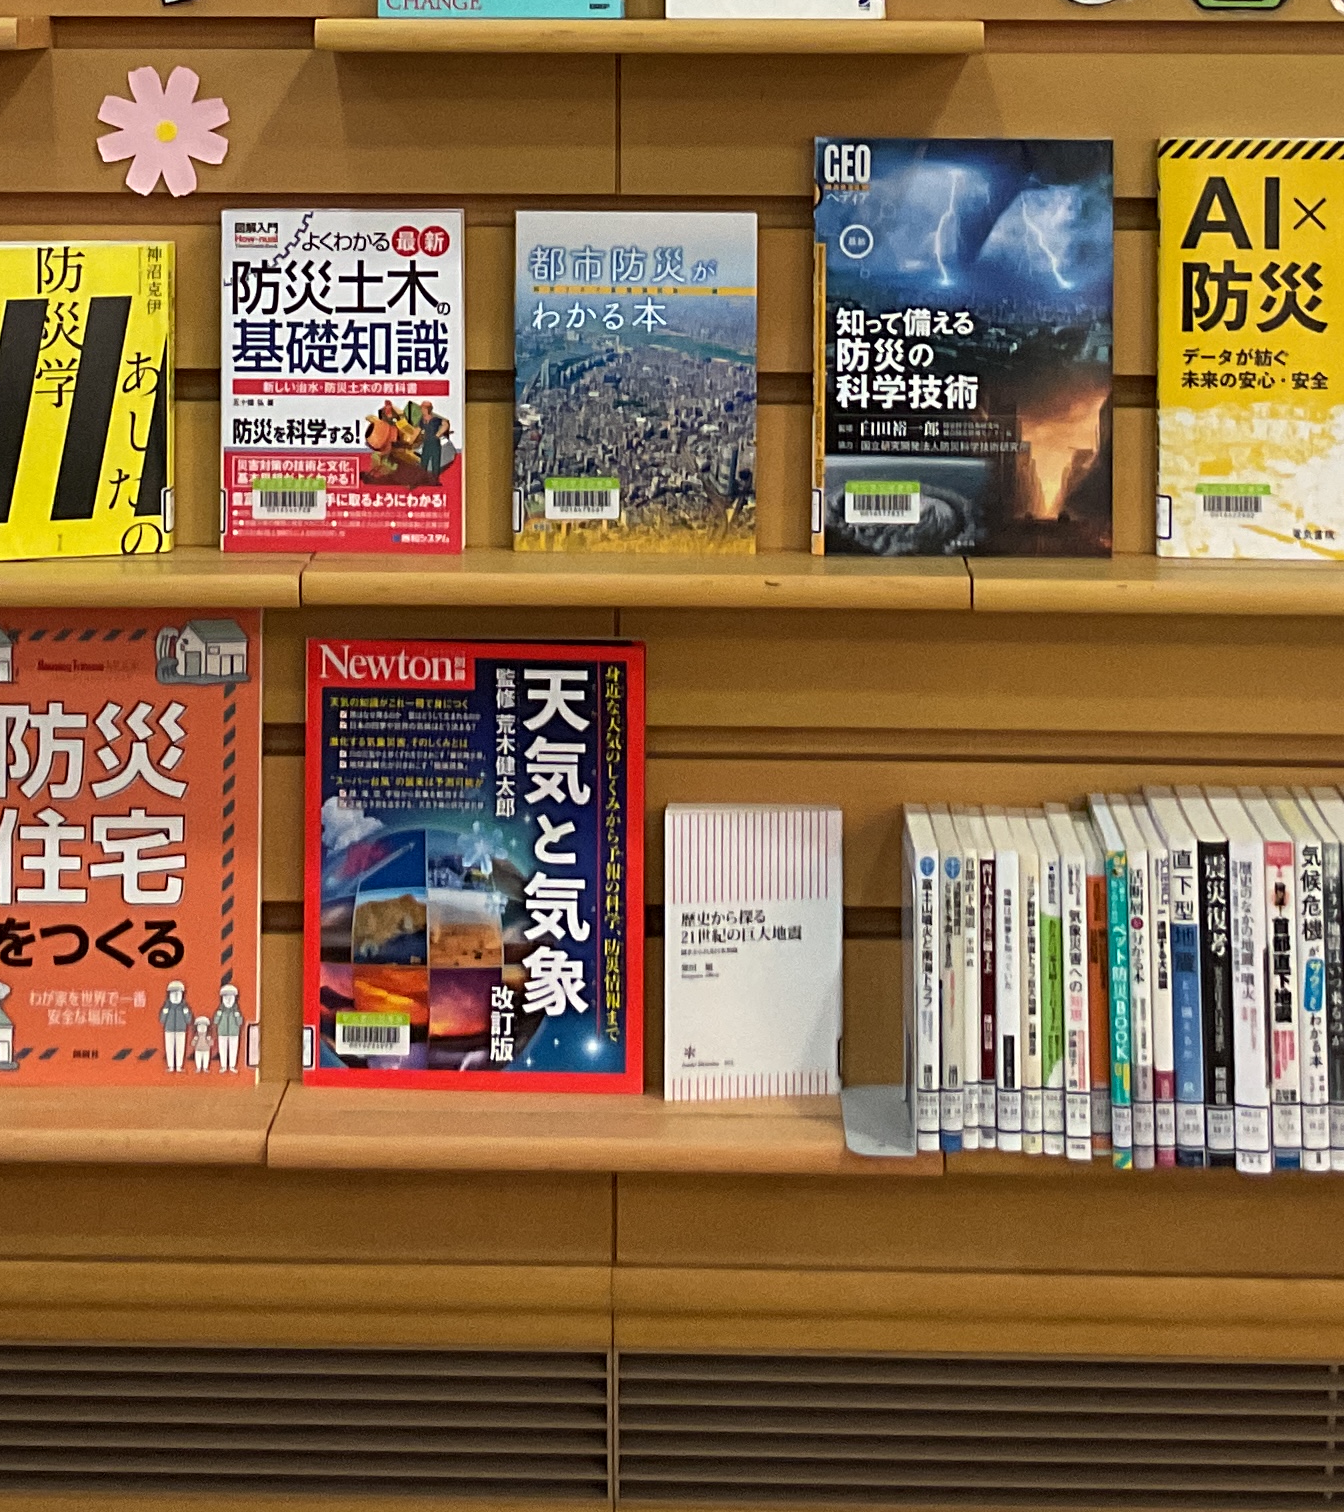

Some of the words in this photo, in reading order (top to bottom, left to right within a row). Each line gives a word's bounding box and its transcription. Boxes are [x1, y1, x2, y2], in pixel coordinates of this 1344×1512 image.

[824, 144, 871, 183] GEO
[234, 222, 279, 234] 図解入門
[302, 231, 389, 251] よくわかる
[396, 230, 445, 253] 最新
[146, 247, 162, 315] 神沼克伊
[530, 246, 717, 284] 都市防災が
[231, 261, 451, 316] 防災土木の
[1181, 261, 1329, 334] 防災
[36, 246, 85, 409] 防災学
[532, 298, 667, 333] わかる本
[836, 309, 974, 338] 知って備える
[232, 319, 449, 374] 基礎知識
[836, 338, 934, 369] 防災の
[1182, 347, 1286, 368] データが紡ぐ
[263, 382, 418, 394] 新しい治水・防災土木の教科書
[836, 374, 978, 410] 科学技術
[1181, 370, 1328, 390] 未来の安心・安全
[233, 418, 361, 445] 防災を科学する！
[109, 351, 162, 555] あしたの
[319, 644, 453, 681] Newton
[495, 668, 516, 709] 監修
[495, 715, 516, 818] 荒木健太郎
[522, 668, 590, 1017] 天気と気象
[681, 909, 765, 927] 歴史から探る
[681, 924, 802, 944] 21世紀の巨大地震
[29, 989, 147, 1009] わが家を世界で一番
[47, 1009, 127, 1026] 安全な場所に
[490, 986, 514, 1062] 改訂版
